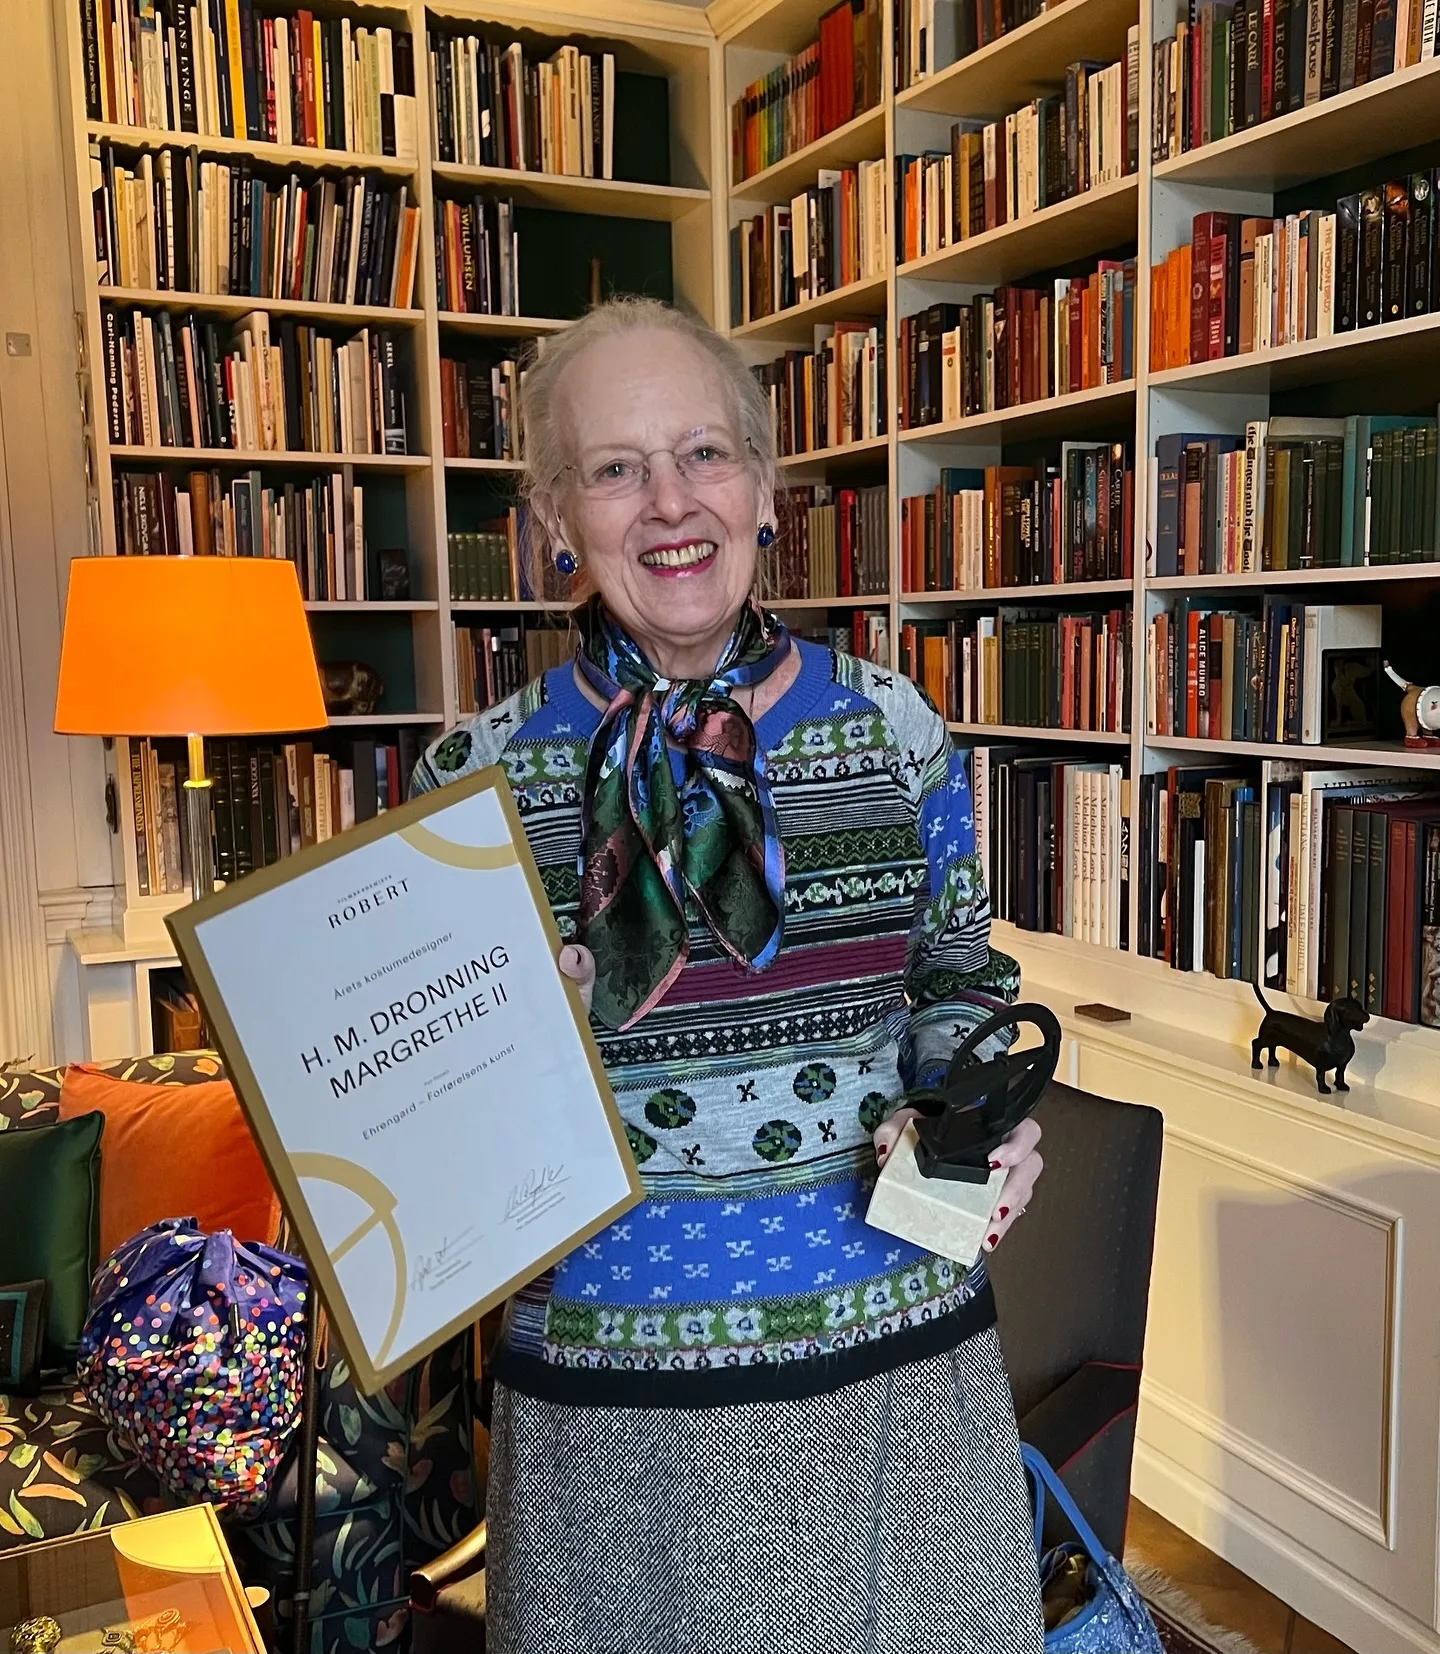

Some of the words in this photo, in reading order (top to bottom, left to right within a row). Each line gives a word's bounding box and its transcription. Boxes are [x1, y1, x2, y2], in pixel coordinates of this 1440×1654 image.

[177, 4, 188, 49] HANS
[1248, 11, 1258, 30] LE
[1275, 23, 1285, 44] LE
[1423, 12, 1435, 44] TRUTH
[1308, 31, 1321, 79] House
[181, 56, 192, 112] LYNGE
[461, 213, 473, 290] WILLUMSEN
[1324, 247, 1332, 283] THORN
[1323, 286, 1331, 313] BIRDS
[106, 313, 117, 384] Carl-Henning
[111, 387, 120, 438] Pedersen
[1247, 426, 1257, 445] the
[1244, 492, 1254, 516] and
[1244, 518, 1254, 537] the
[1198, 628, 1206, 658] ALICE
[1198, 660, 1206, 697] MUNRO
[131, 754, 141, 769] THE
[250, 757, 259, 782] GOGH
[132, 771, 144, 832] IMPRESSIONISTS
[1074, 794, 1082, 846] Melchior
[1082, 795, 1090, 848] Melchior
[1090, 796, 1098, 849] Melchior
[1090, 852, 1098, 884] Lorck
[328, 877, 409, 929] ROBERT
[333, 980, 362, 1000] Årets
[364, 932, 453, 984] kostumedesigner
[300, 1046, 331, 1074] H.
[333, 1026, 368, 1056] M.
[369, 945, 510, 1036] DRONNING
[329, 993, 490, 1099] MARGRETHE
[491, 982, 508, 1006] II
[362, 1102, 417, 1140] Ehrengard
[426, 1061, 488, 1101] Forførelsens
[488, 1043, 516, 1065] kunst
